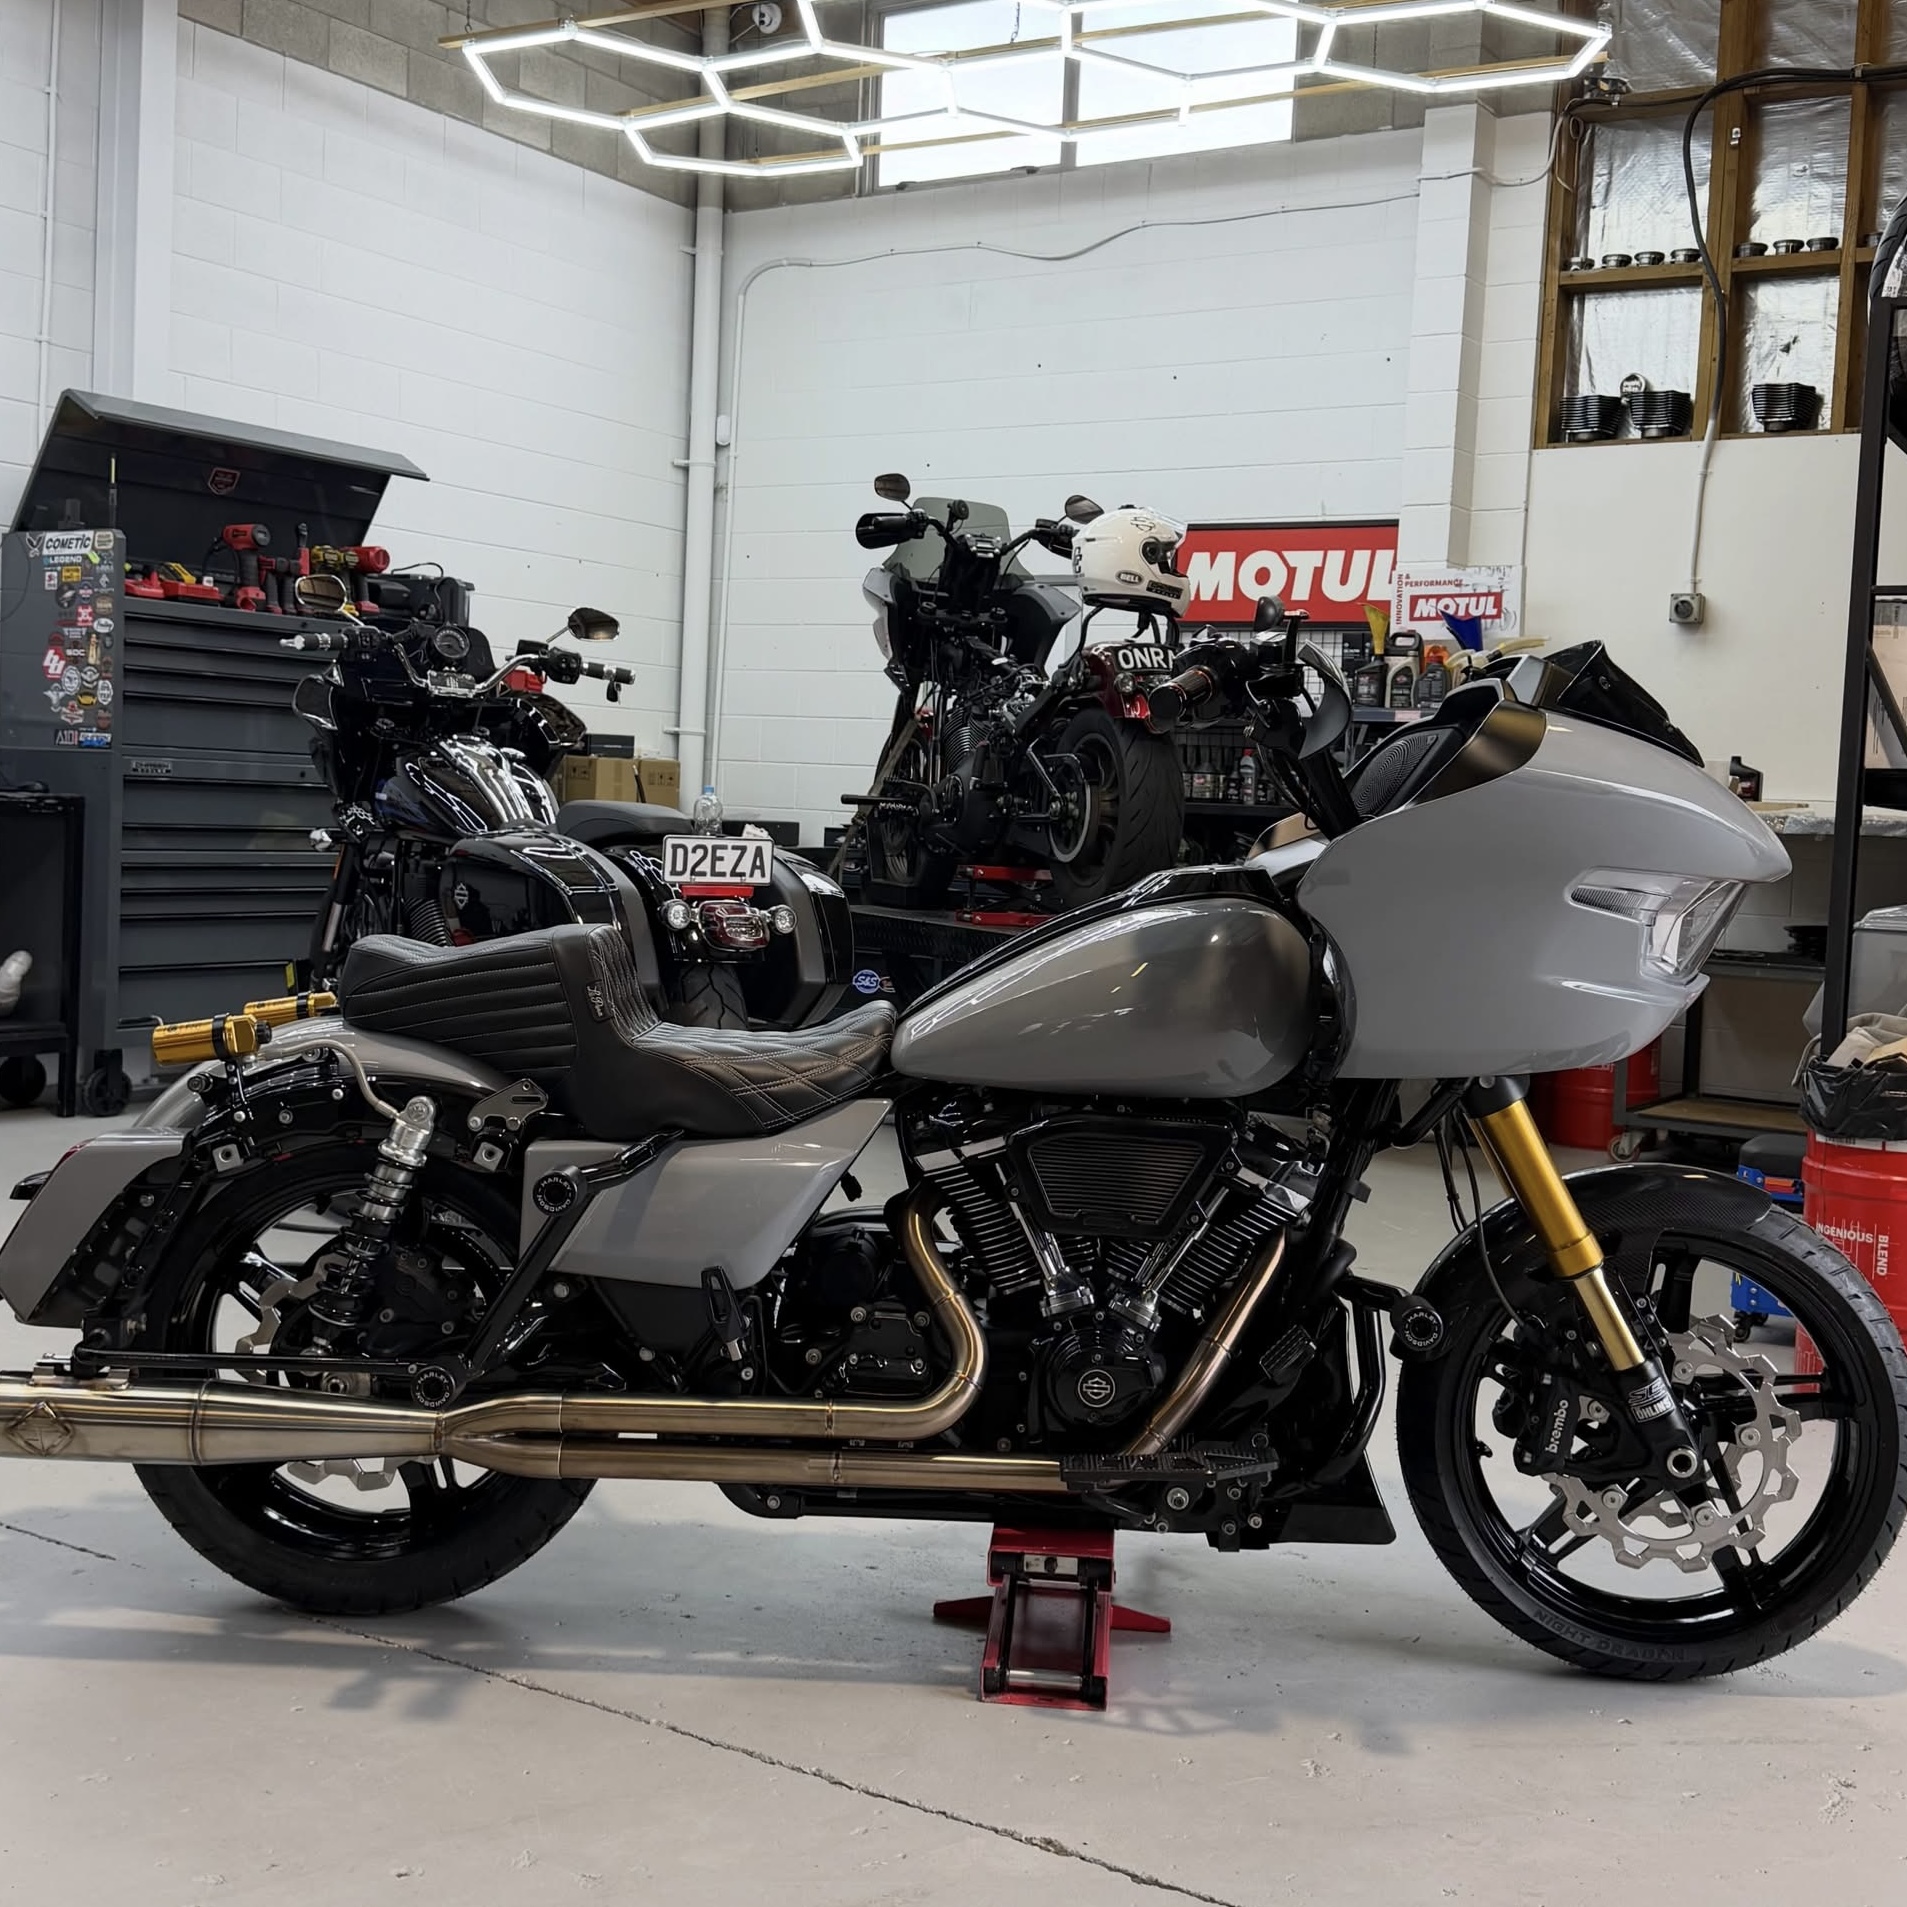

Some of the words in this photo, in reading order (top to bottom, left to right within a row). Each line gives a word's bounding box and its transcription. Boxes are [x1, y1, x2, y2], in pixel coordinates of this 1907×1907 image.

[1120, 573, 1140, 583] BELL
[1187, 549, 1395, 602] MOTUL
[1405, 579, 1463, 588] PERFORMANCE
[1413, 596, 1498, 618] MOTUL
[670, 843, 766, 878] D2EZA
[857, 976, 877, 987] S&S
[1816, 1223, 1874, 1243] INGENIOUS
[1876, 1234, 1889, 1276] BLEND
[1545, 1399, 1569, 1453] brembo
[1532, 1609, 1591, 1642] NIGHT
